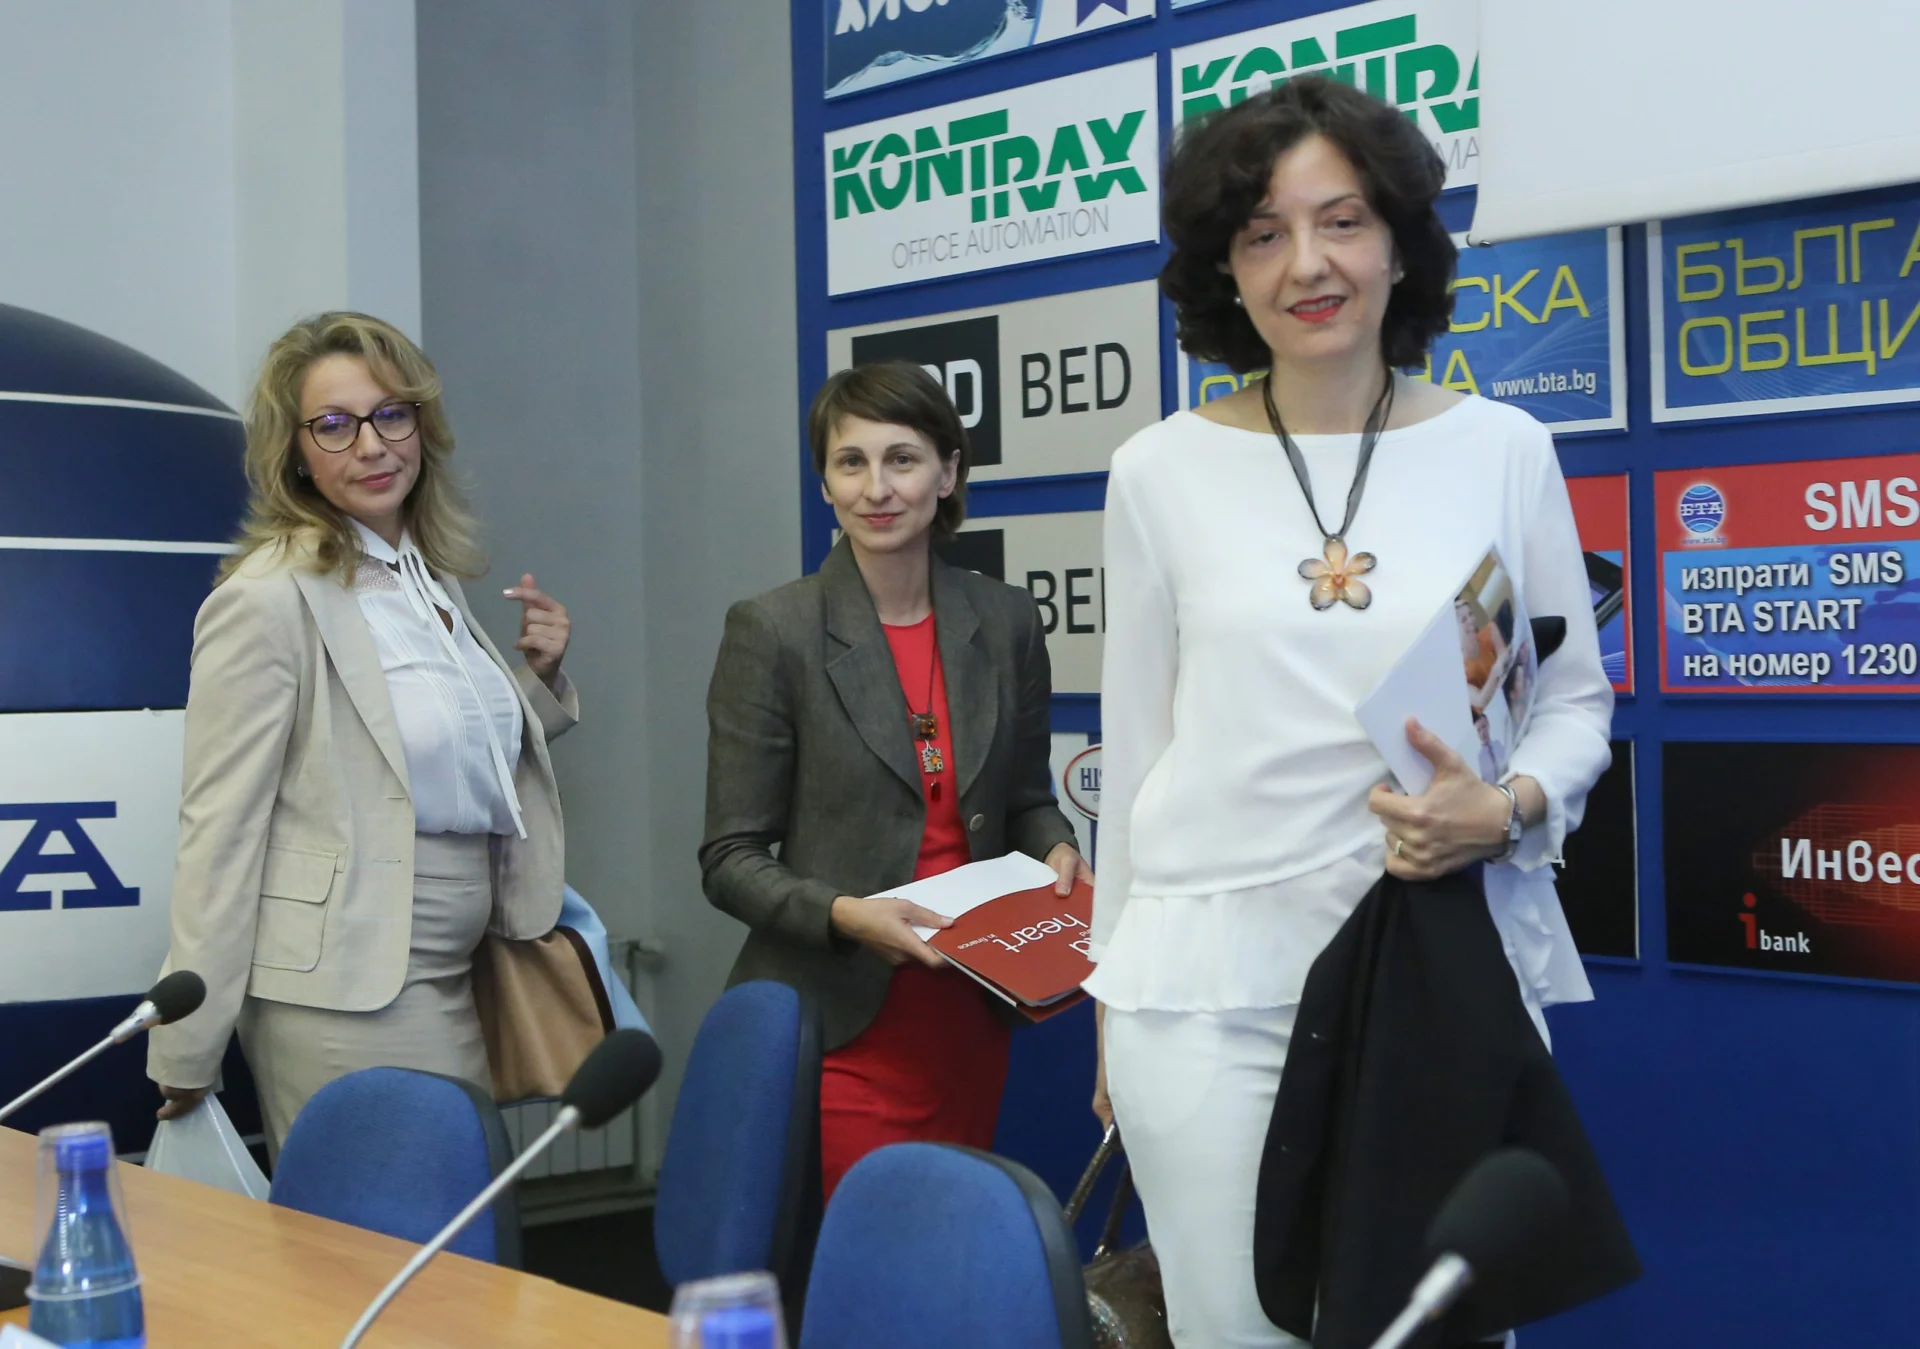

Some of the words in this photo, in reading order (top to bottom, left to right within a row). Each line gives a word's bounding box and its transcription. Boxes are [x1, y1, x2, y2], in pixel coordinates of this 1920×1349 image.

[833, 108, 1148, 223] KONTRAX
[892, 230, 959, 269] OFFICE
[965, 205, 1109, 256] AUTOMATION
[1021, 342, 1132, 418] BED
[1492, 368, 1597, 396] www.bta.bg
[1804, 477, 1920, 531] SMS
[1681, 563, 1809, 595] изпрати
[1829, 551, 1904, 585] SMS
[1026, 567, 1106, 635] BE
[1682, 602, 1746, 634] BTA
[1753, 598, 1862, 632] START
[1683, 654, 1719, 677] на
[1729, 650, 1831, 683] номер
[1841, 643, 1918, 675] 1230
[992, 913, 1089, 953] heart
